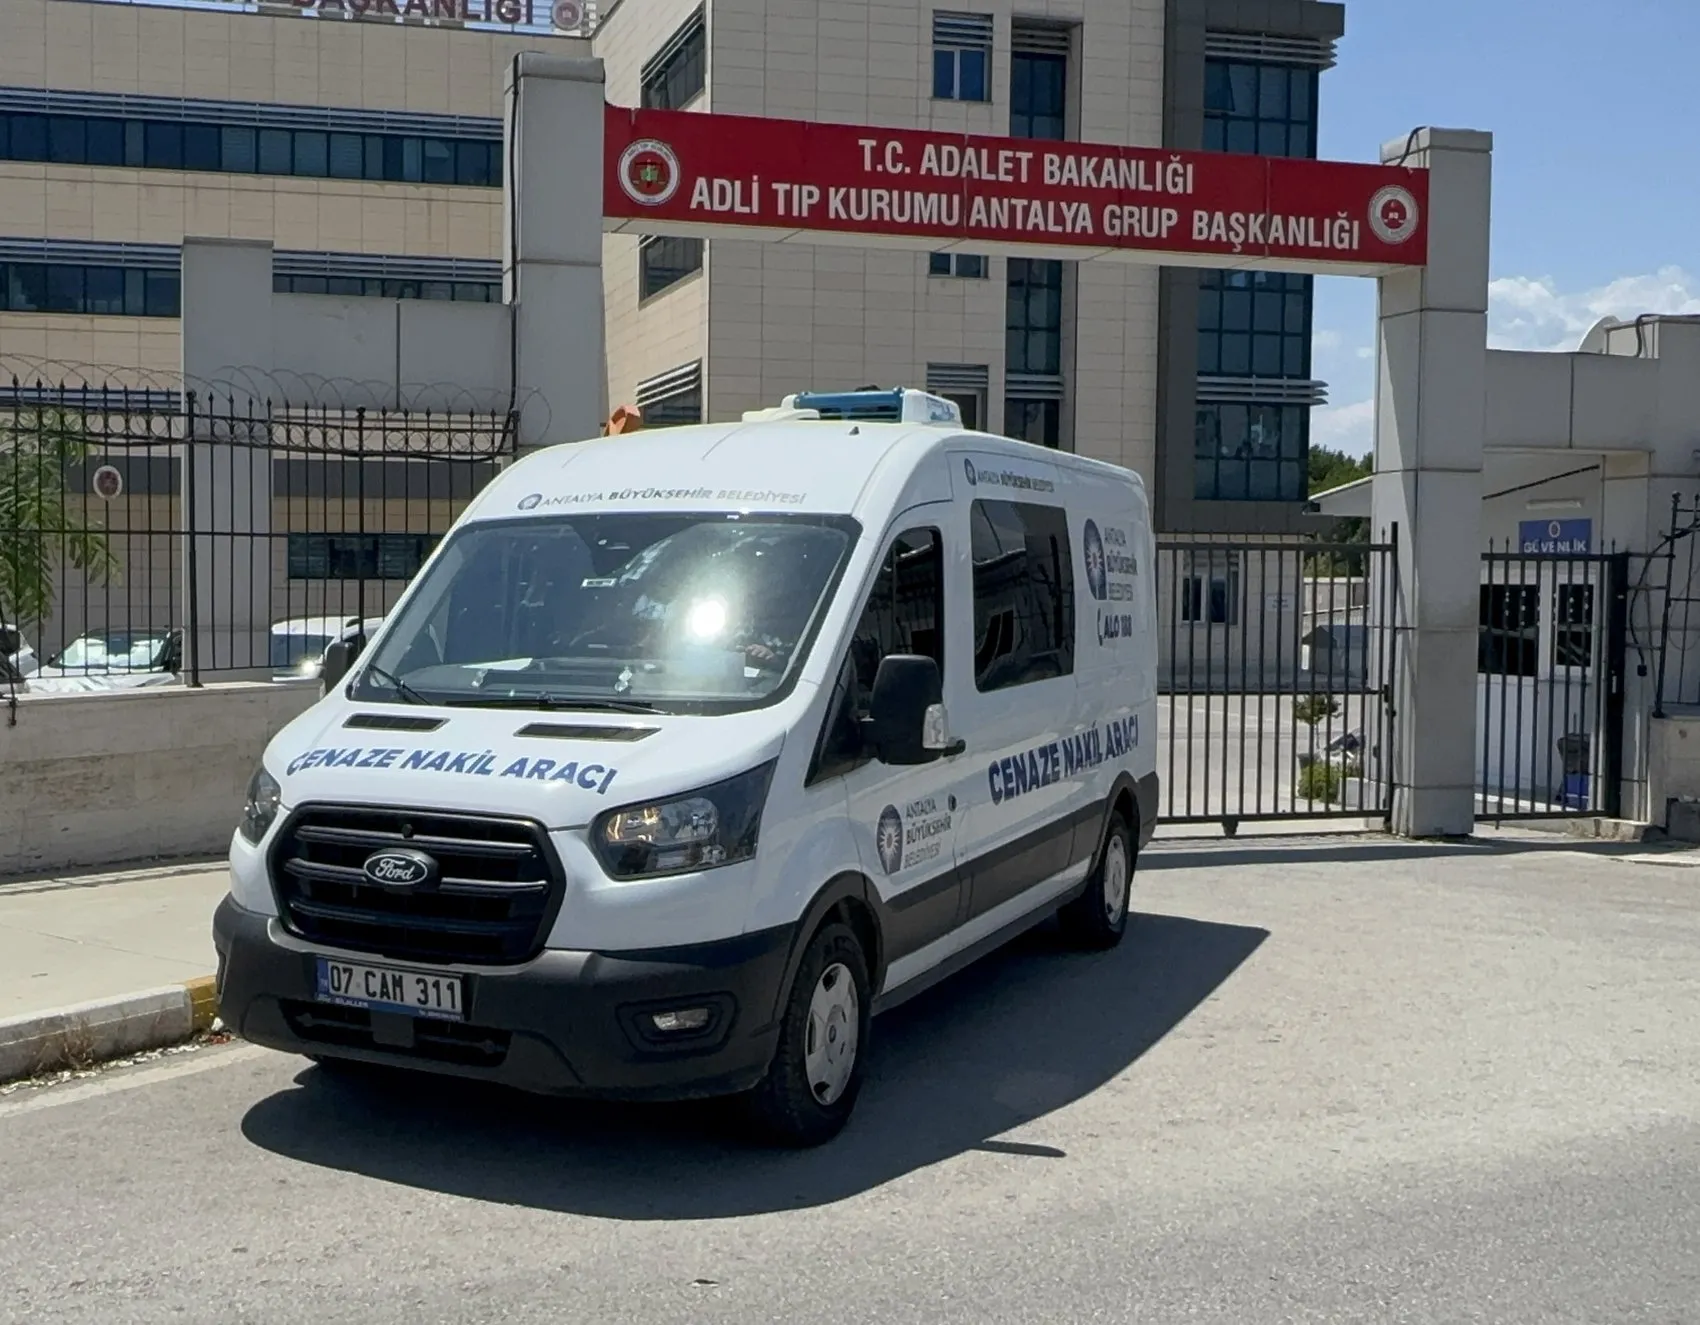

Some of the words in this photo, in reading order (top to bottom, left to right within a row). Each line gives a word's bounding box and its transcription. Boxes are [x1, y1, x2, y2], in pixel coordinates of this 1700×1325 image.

[291, 0, 533, 24] KANLIĞI
[858, 139, 911, 174] T.C.
[920, 143, 1033, 183] ADALET
[1043, 153, 1193, 194] BAKANLIĞI
[690, 174, 759, 214] ADLİ
[771, 182, 820, 217] TIP
[828, 187, 960, 226] KURUMU
[968, 195, 1094, 235] ANTALYA
[1102, 204, 1179, 239] GRUP
[1191, 210, 1360, 253] BAŞKANLIĞI
[541, 493, 604, 507] ANTALYA
[1523, 537, 1587, 553] GÜVENLİK
[1103, 615, 1120, 639] ALO
[286, 747, 405, 776] CENAZE
[400, 749, 498, 776] NAKİL
[500, 757, 618, 795] ARACI
[988, 742, 1061, 806] CENAZE
[1060, 720, 1103, 778] NAKİL
[1104, 714, 1139, 762] ARACI
[905, 798, 937, 819] ANTALYA
[375, 858, 415, 880] Ford
[330, 965, 354, 994] 07
[415, 977, 457, 1010] 311
